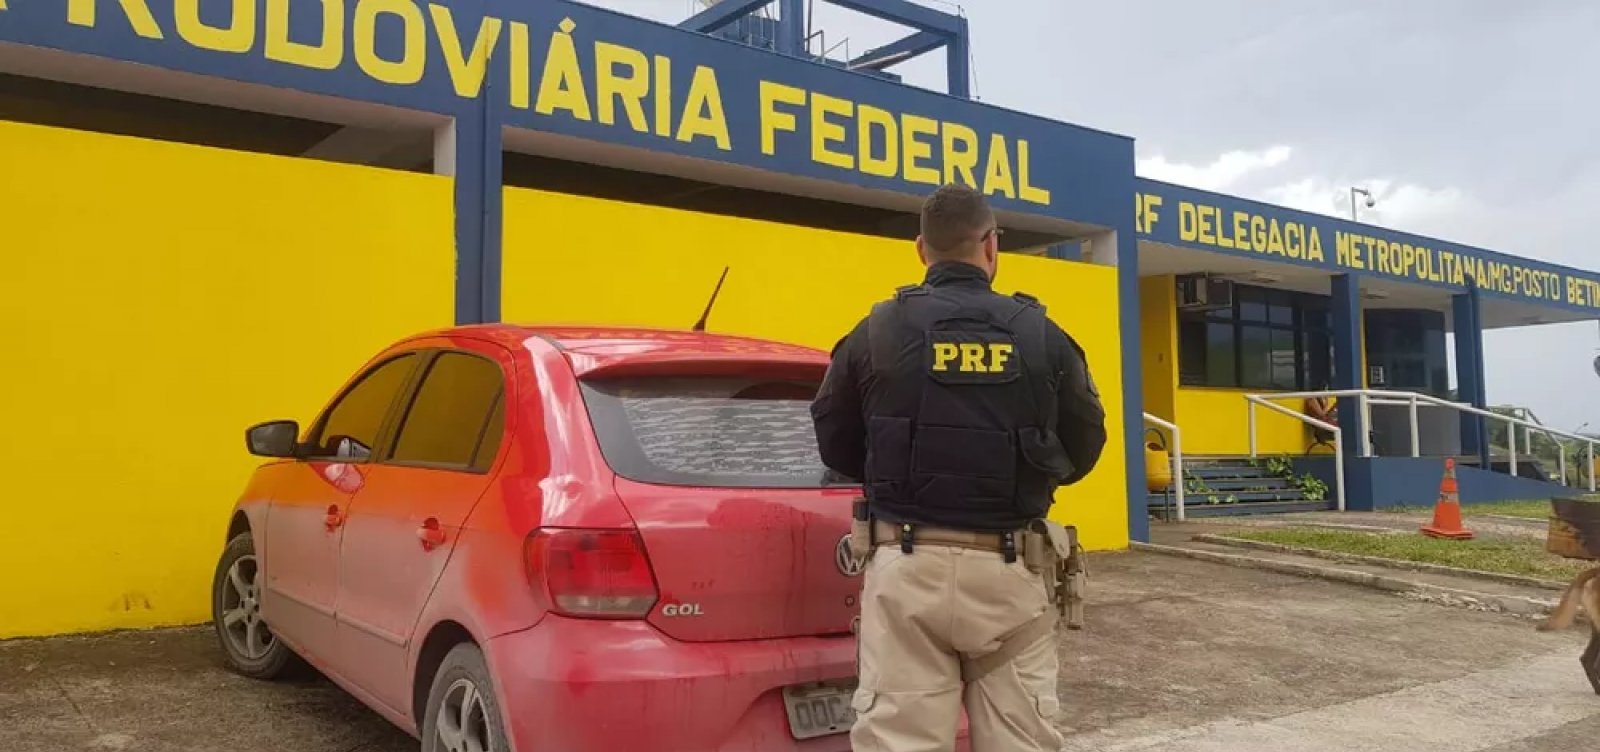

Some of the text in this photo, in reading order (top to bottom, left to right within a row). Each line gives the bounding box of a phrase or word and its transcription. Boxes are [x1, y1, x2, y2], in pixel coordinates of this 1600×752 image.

[759, 79, 1051, 205] FEDERAL
[1178, 201, 1325, 263] DELEGACIA
[1565, 275, 1600, 308] BETI
[932, 343, 1014, 373] PRF
[662, 603, 705, 617] GOL
